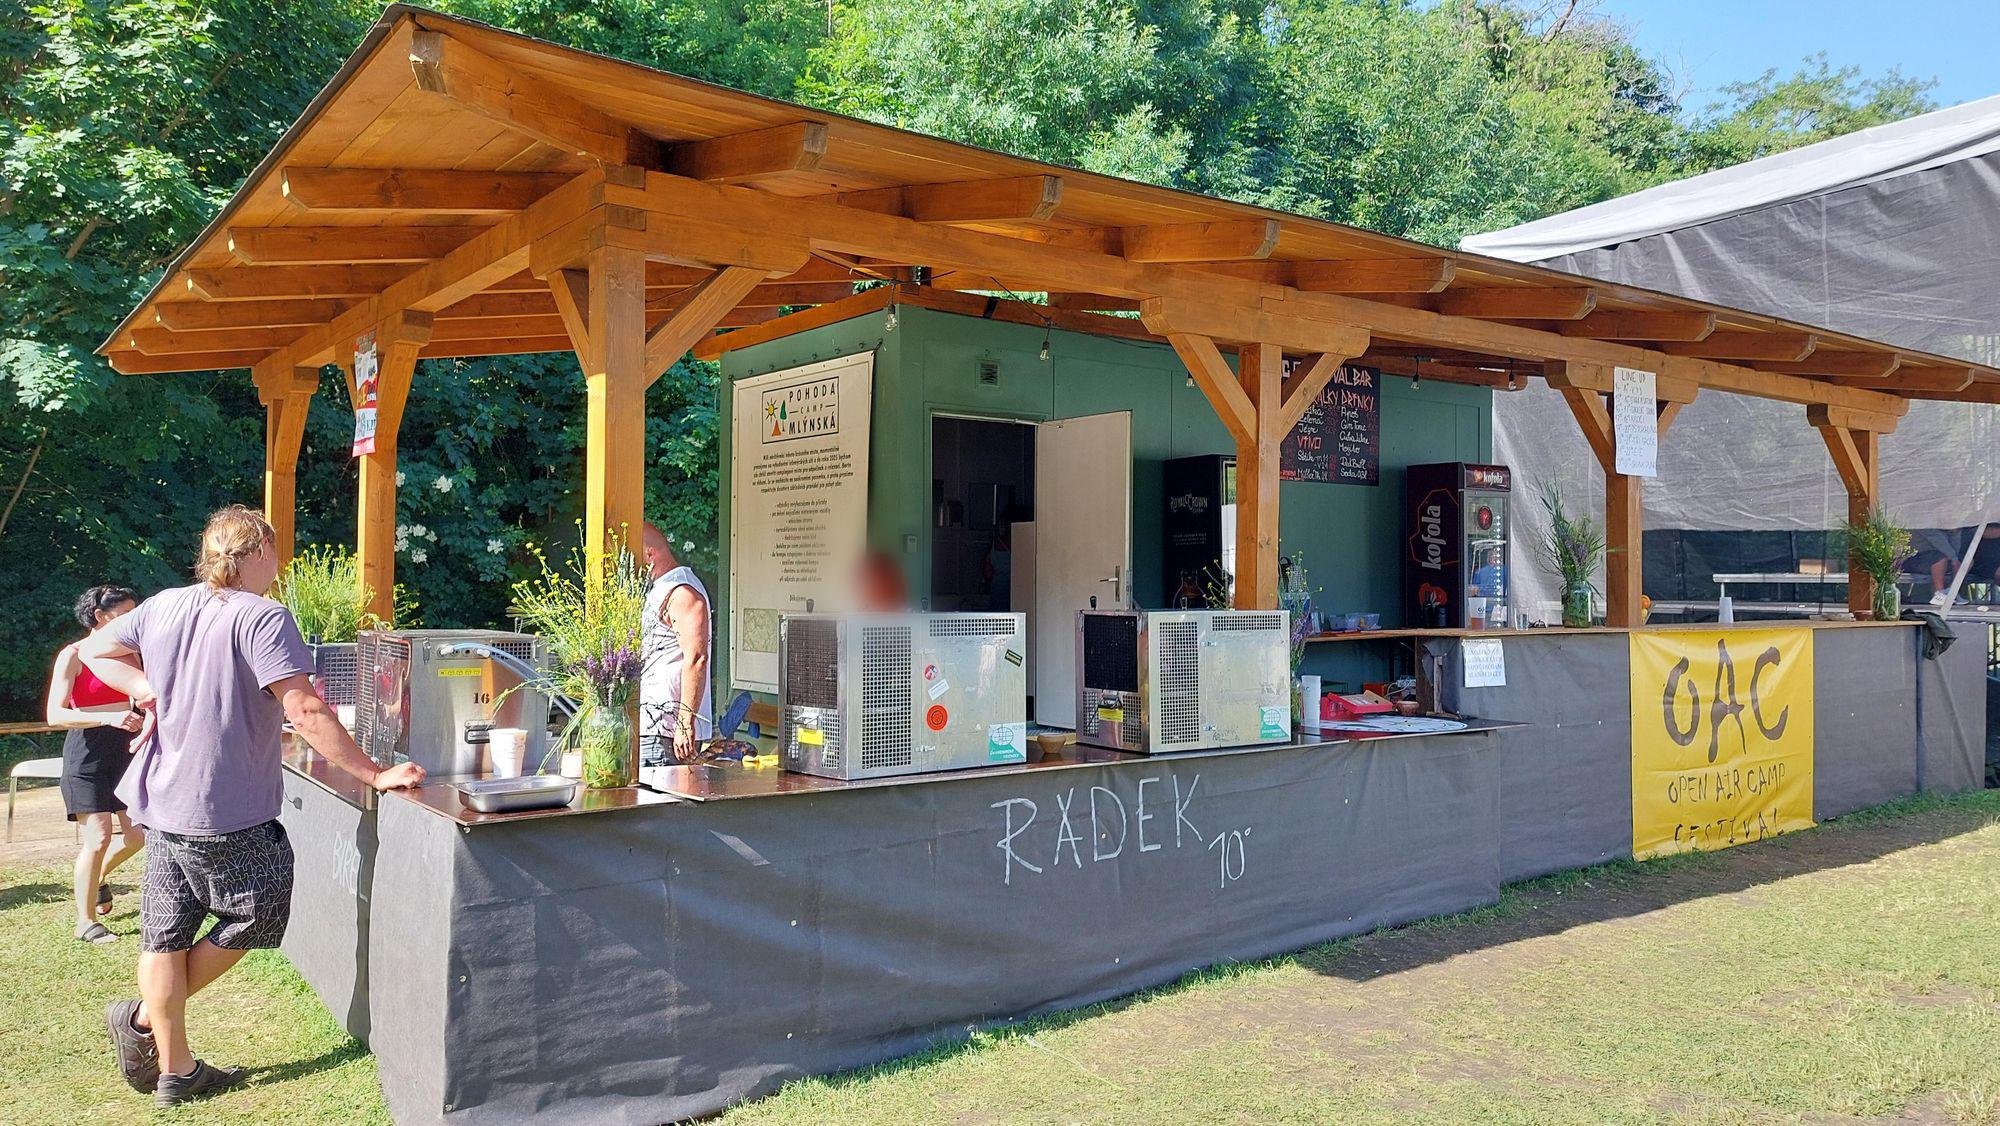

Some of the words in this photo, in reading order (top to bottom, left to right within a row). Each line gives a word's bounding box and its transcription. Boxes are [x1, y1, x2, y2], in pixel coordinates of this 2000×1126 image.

[1353, 368, 1373, 388] BAR
[1621, 370, 1637, 382] LINE
[1639, 373, 1646, 383] UP
[789, 382, 837, 403] POHODA
[800, 403, 823, 415] CAMP
[788, 411, 836, 435] MLÝNSKÁ
[1483, 470, 1503, 486] kofola
[1421, 505, 1446, 570] kofola
[474, 692, 491, 704] 16
[1663, 638, 1789, 763] OAC
[1668, 772, 1708, 806] OPEN
[1715, 768, 1743, 802] AIR
[1747, 762, 1786, 795] CAMP
[991, 774, 1203, 886] RADEK
